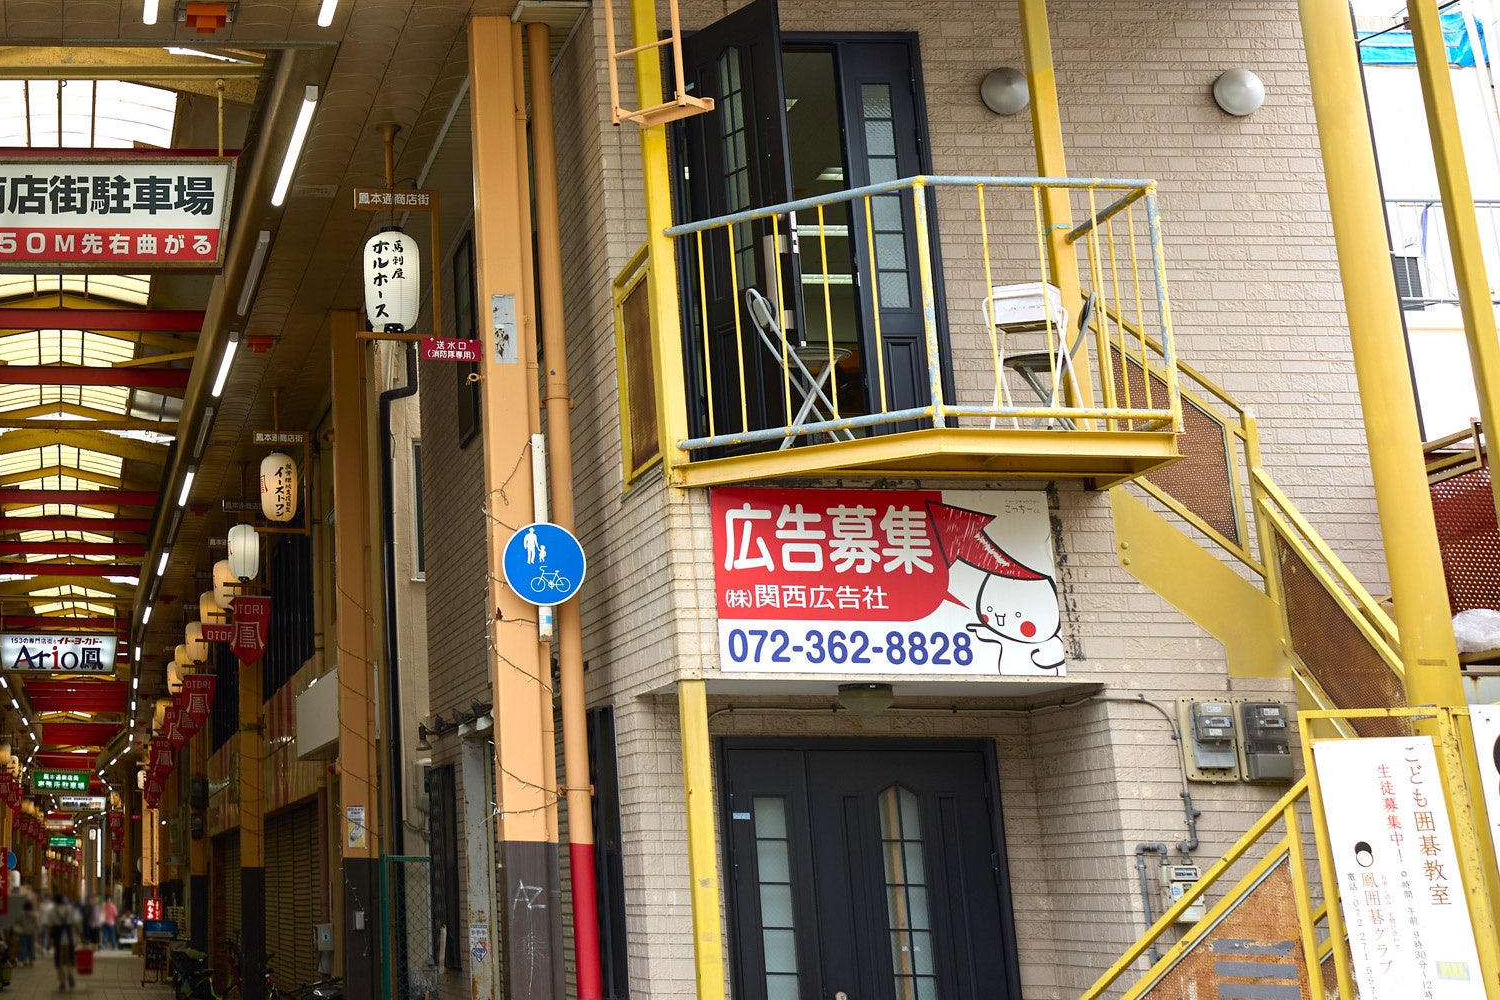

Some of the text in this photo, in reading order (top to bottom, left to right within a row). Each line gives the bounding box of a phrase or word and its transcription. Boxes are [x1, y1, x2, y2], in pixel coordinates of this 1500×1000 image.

[358, 192, 430, 206] 鳳本通商店街
[372, 240, 390, 318] ホルホース
[436, 341, 467, 350] 送水口
[724, 503, 934, 575] 広告募集
[207, 630, 231, 641] OTO
[728, 628, 974, 666] 072-362-8828
[186, 680, 211, 689] OTORI
[1378, 764, 1404, 863] 生徒募集中!
[1405, 747, 1452, 906] こども囲碁教室
